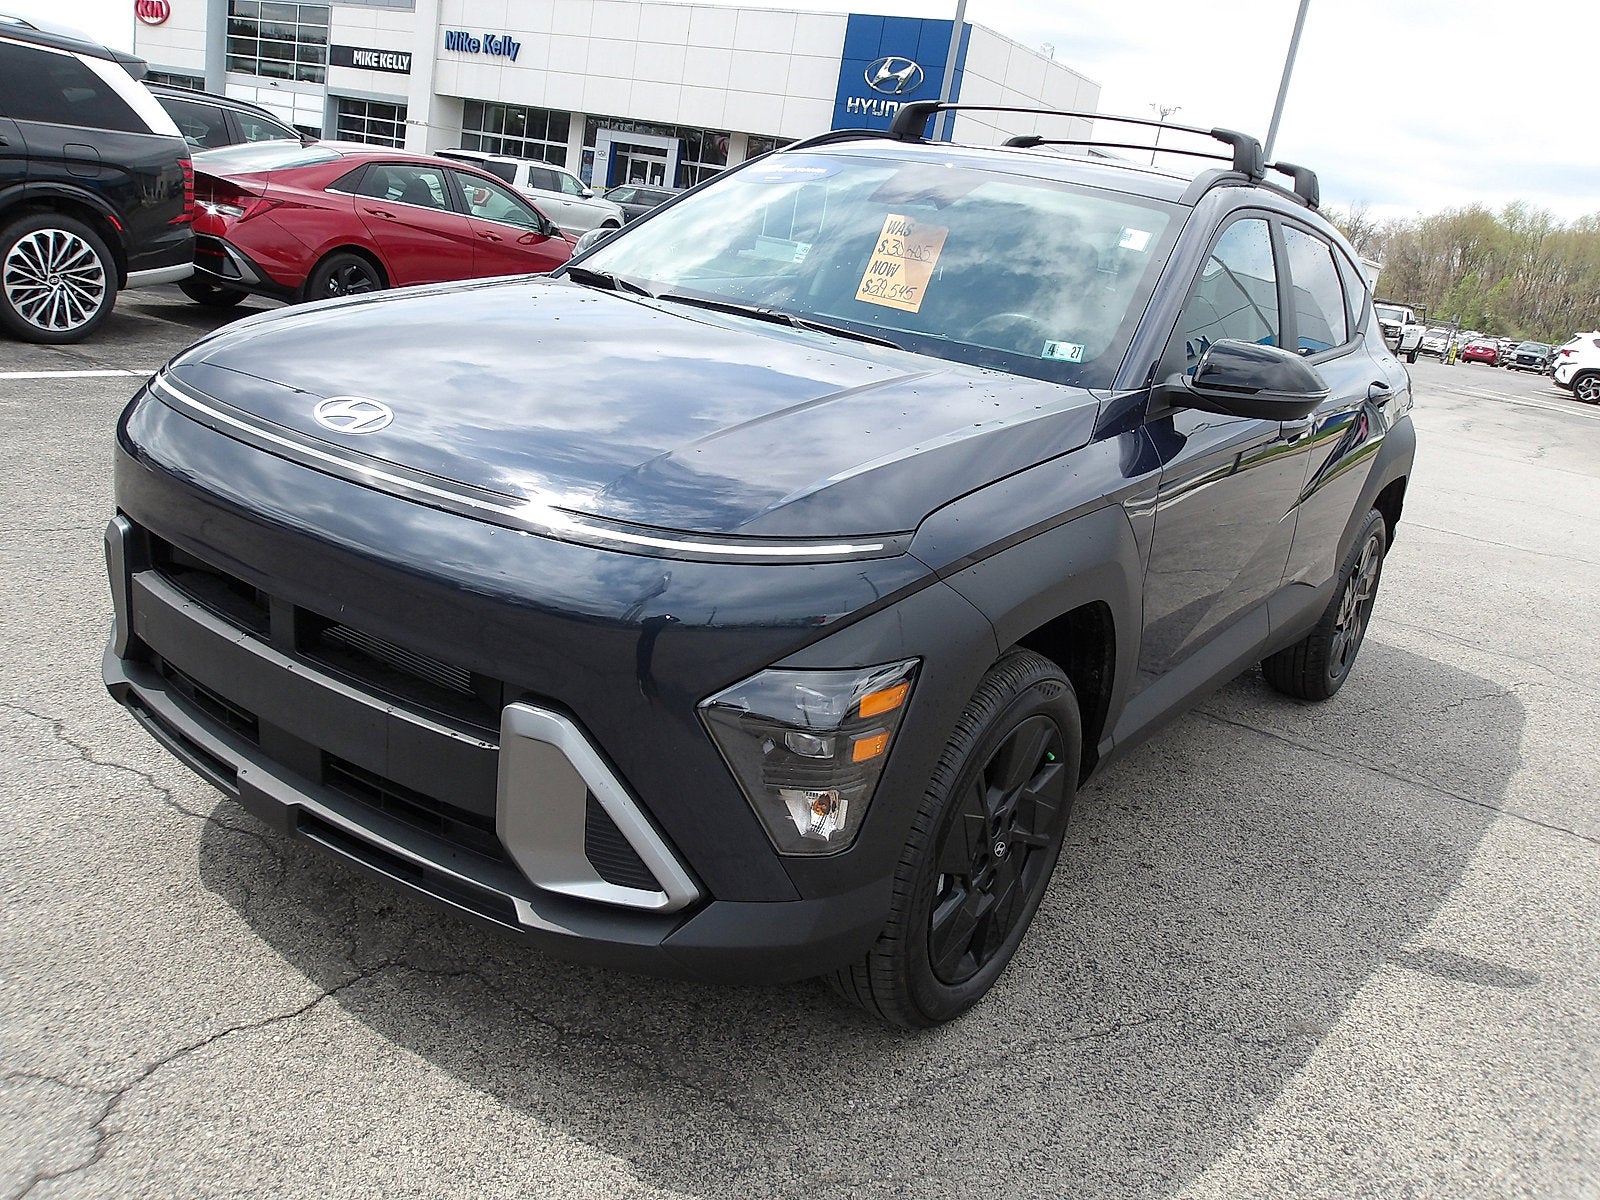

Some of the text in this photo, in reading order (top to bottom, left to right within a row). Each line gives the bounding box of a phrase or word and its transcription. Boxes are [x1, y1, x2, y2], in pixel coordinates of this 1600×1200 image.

[139, 0, 166, 18] KIA
[444, 30, 521, 62] Mike Kelly
[353, 50, 411, 71] MIKE KELLY
[846, 96, 914, 119] HYUN
[886, 220, 914, 237] WAS
[869, 260, 901, 278] NOW
[1047, 343, 1082, 359] 4 27
